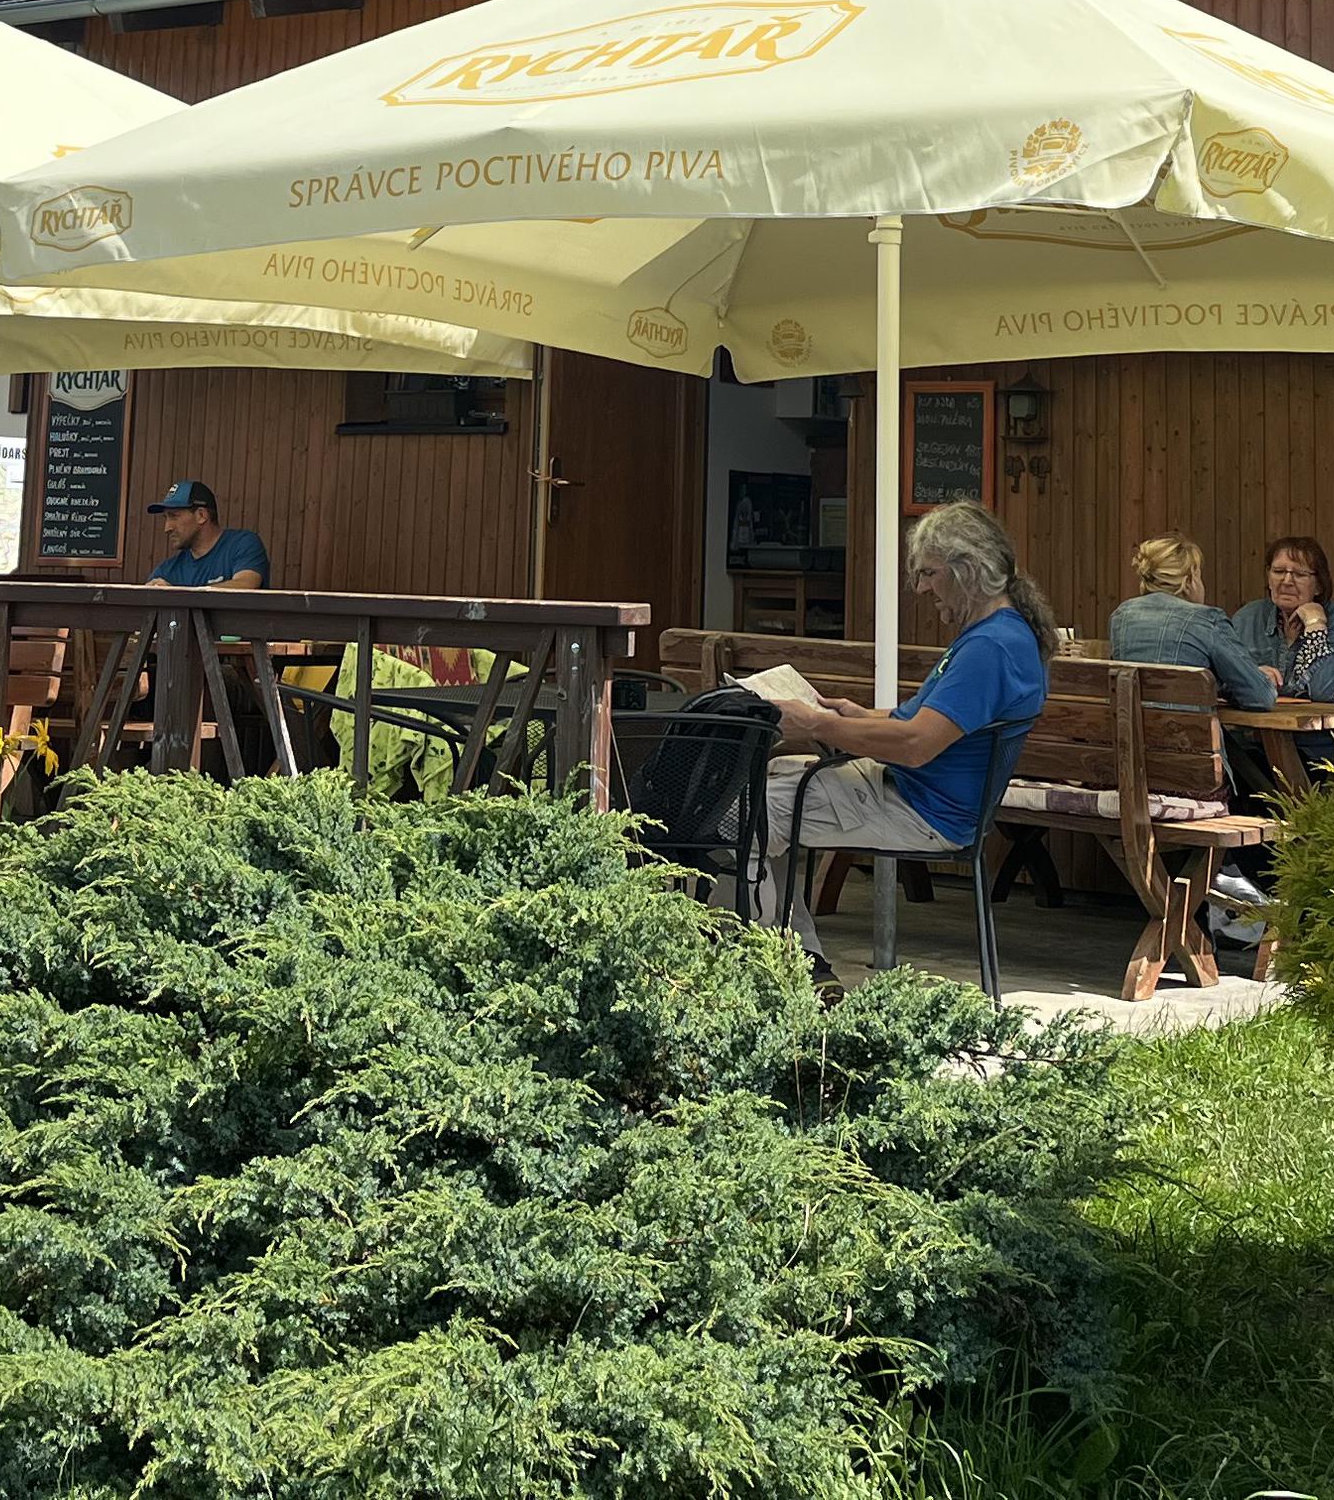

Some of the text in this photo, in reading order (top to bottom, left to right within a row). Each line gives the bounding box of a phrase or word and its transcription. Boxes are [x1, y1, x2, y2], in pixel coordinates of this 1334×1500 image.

[425, 11, 811, 90] RYCHTÁŘ
[288, 146, 725, 208] SPRÁVCE POCTIVÉHO PIVA
[1200, 140, 1281, 187] RYCHTÁŘ
[39, 197, 124, 237] RYCHTÁŘ
